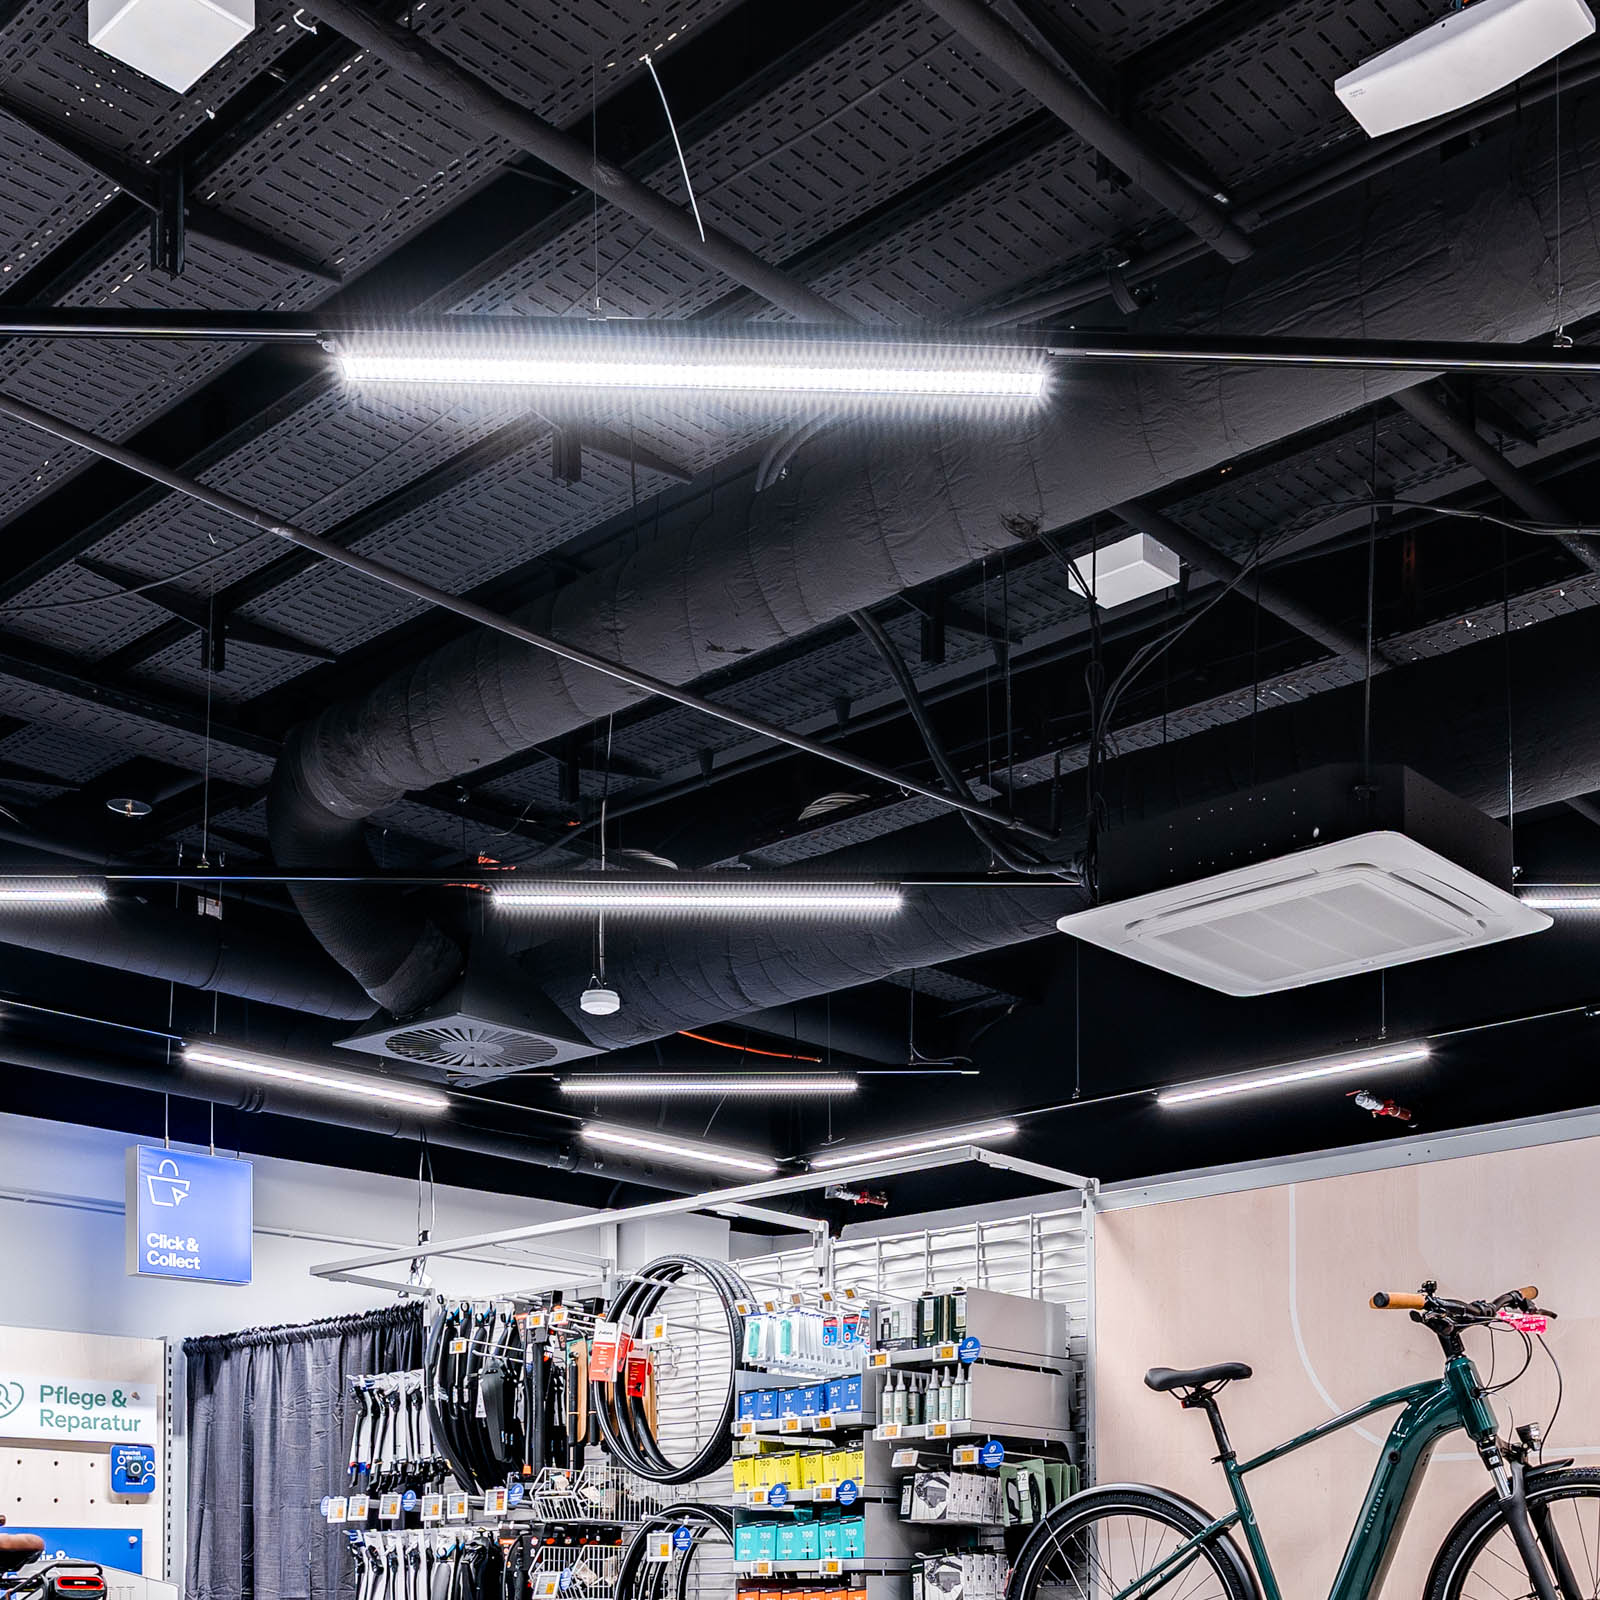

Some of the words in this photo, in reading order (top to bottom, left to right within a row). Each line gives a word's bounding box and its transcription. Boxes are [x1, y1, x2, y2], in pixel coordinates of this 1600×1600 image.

[146, 1233, 184, 1250] Click
[186, 1238, 199, 1252] &
[146, 1250, 201, 1270] Collect
[39, 1384, 107, 1410] Pflege
[111, 1389, 128, 1408] &
[39, 1409, 141, 1433] Reparatur
